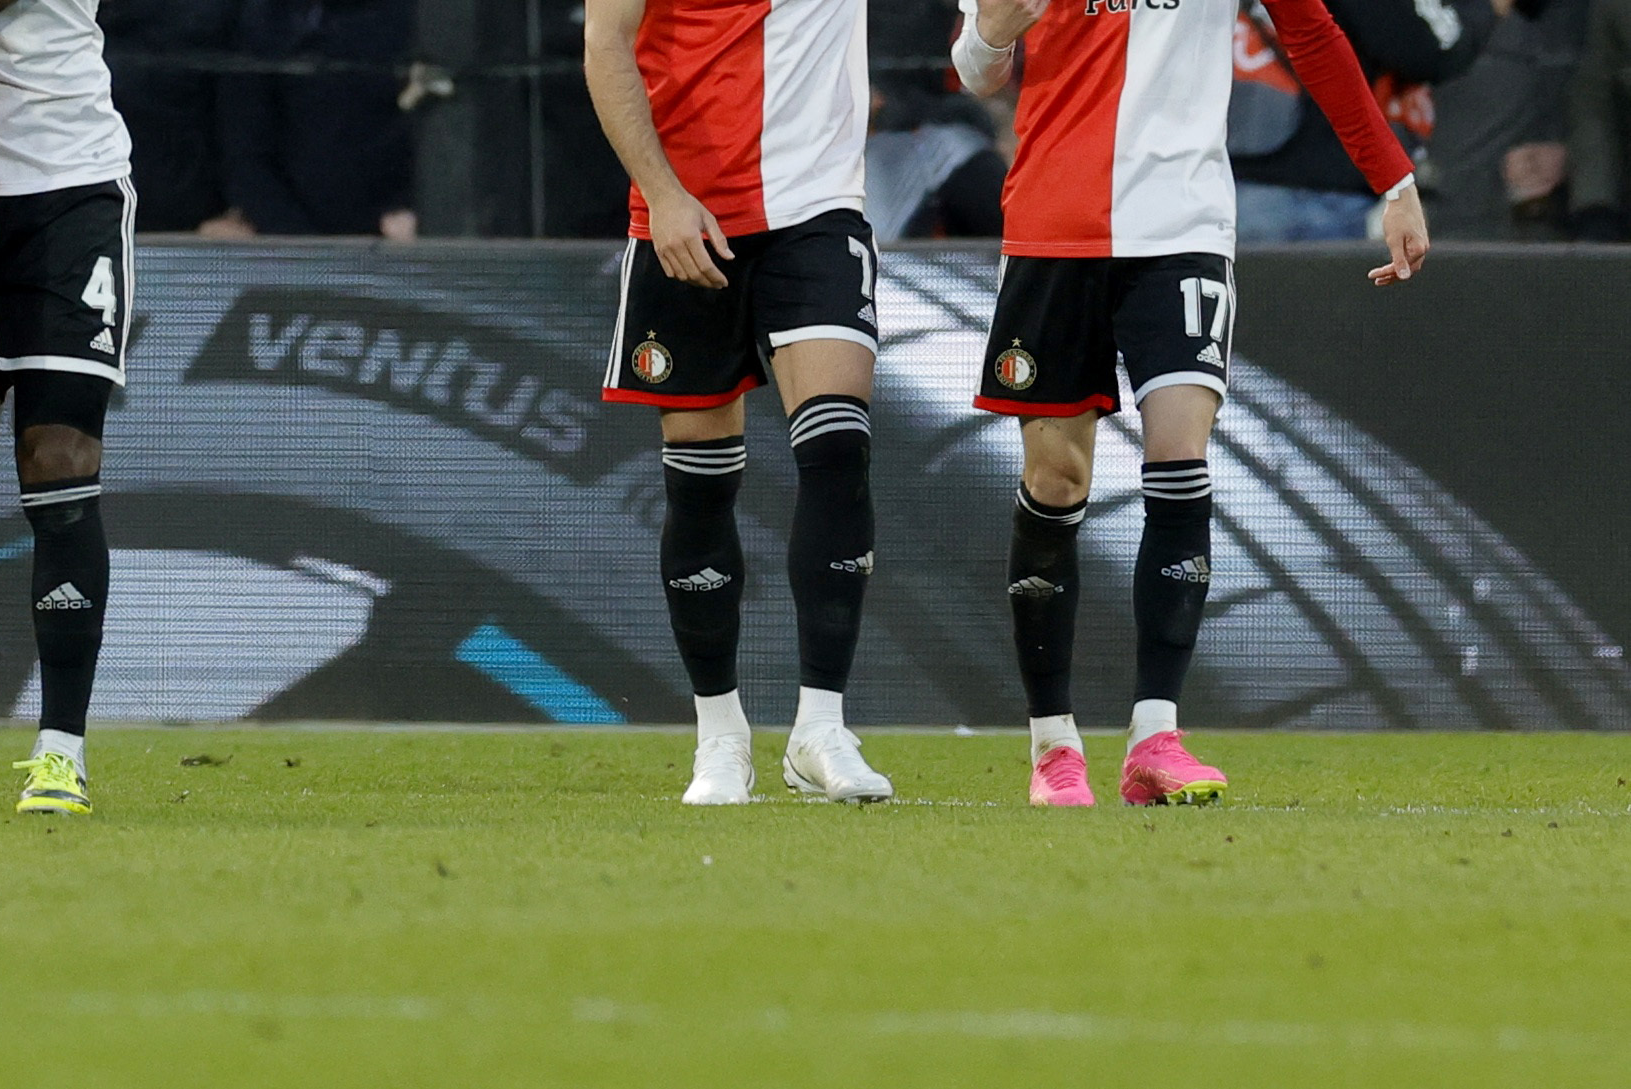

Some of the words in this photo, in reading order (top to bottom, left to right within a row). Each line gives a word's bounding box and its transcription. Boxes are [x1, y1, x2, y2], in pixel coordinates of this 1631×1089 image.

[81, 255, 117, 327] 4
[1179, 276, 1229, 343] 17
[36, 596, 93, 611] adidas
[669, 573, 732, 592] adidas
